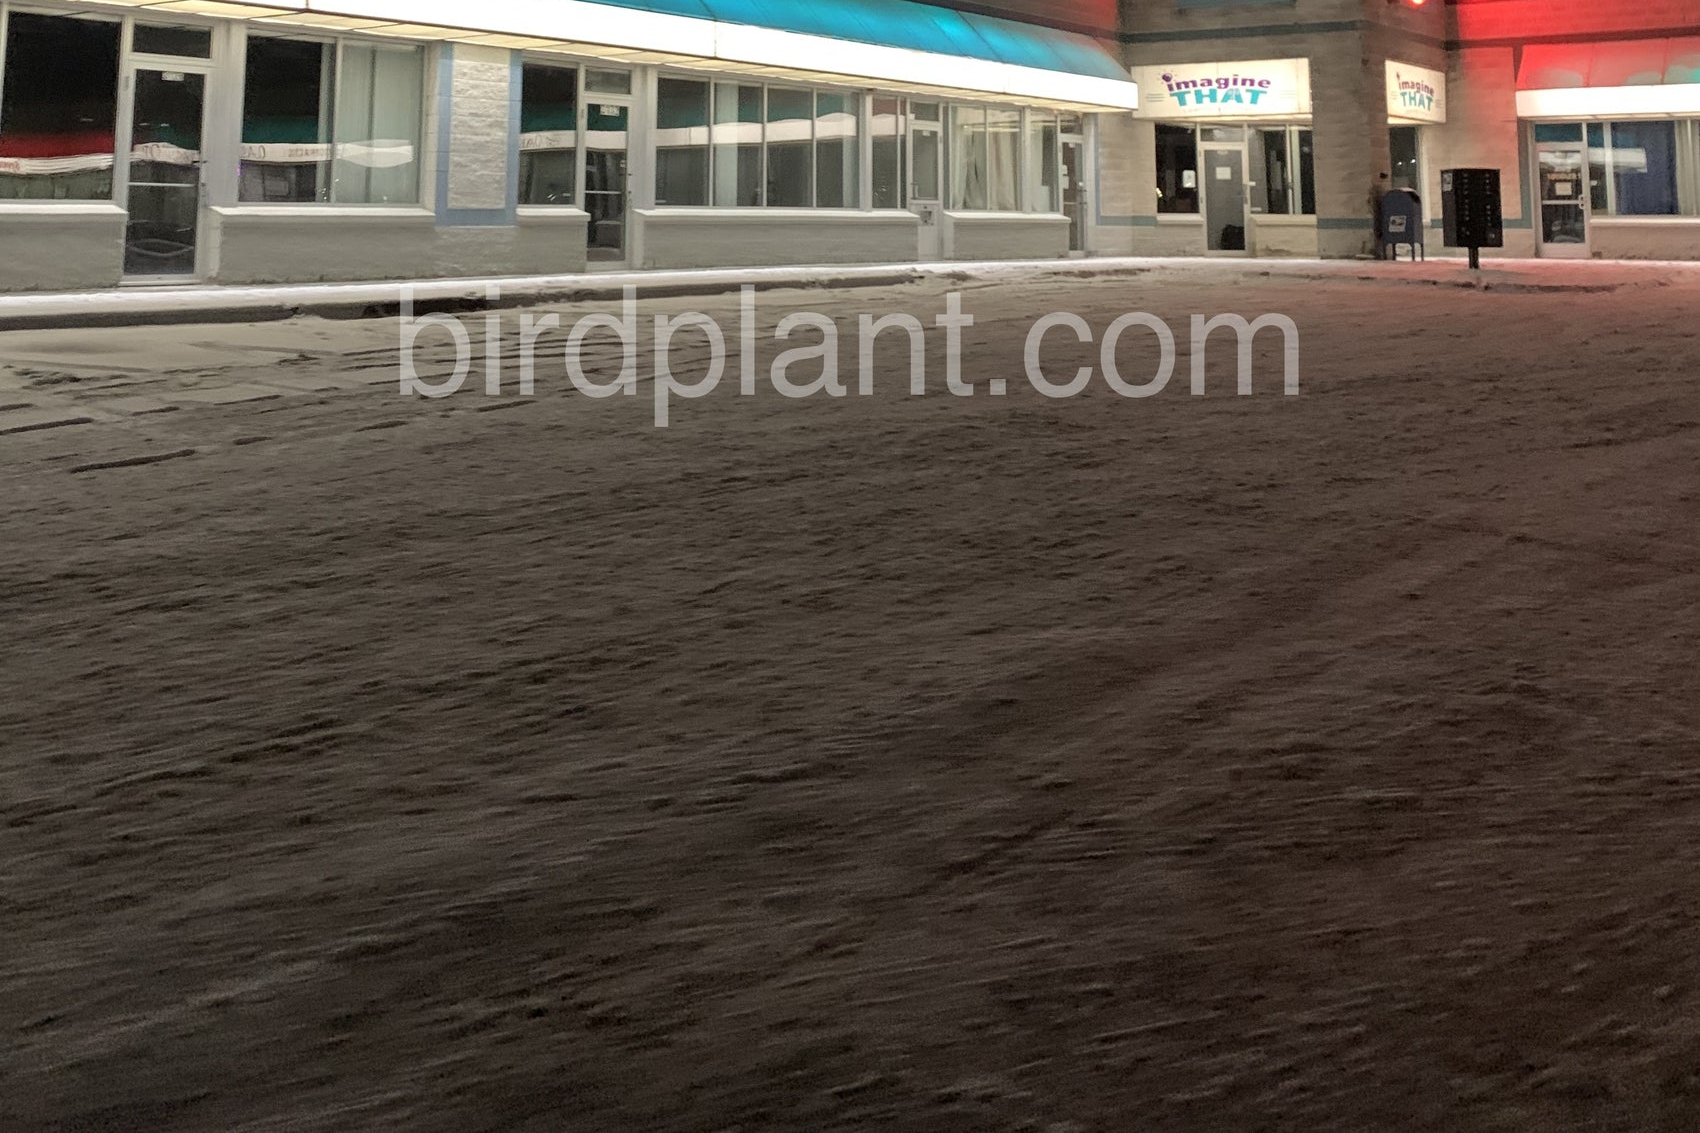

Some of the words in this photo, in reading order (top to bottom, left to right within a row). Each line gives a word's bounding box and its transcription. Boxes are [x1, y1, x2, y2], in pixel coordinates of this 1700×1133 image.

[1162, 73, 1271, 92] imagine
[1170, 88, 1267, 107] THAT
[1400, 91, 1433, 111] THAT
